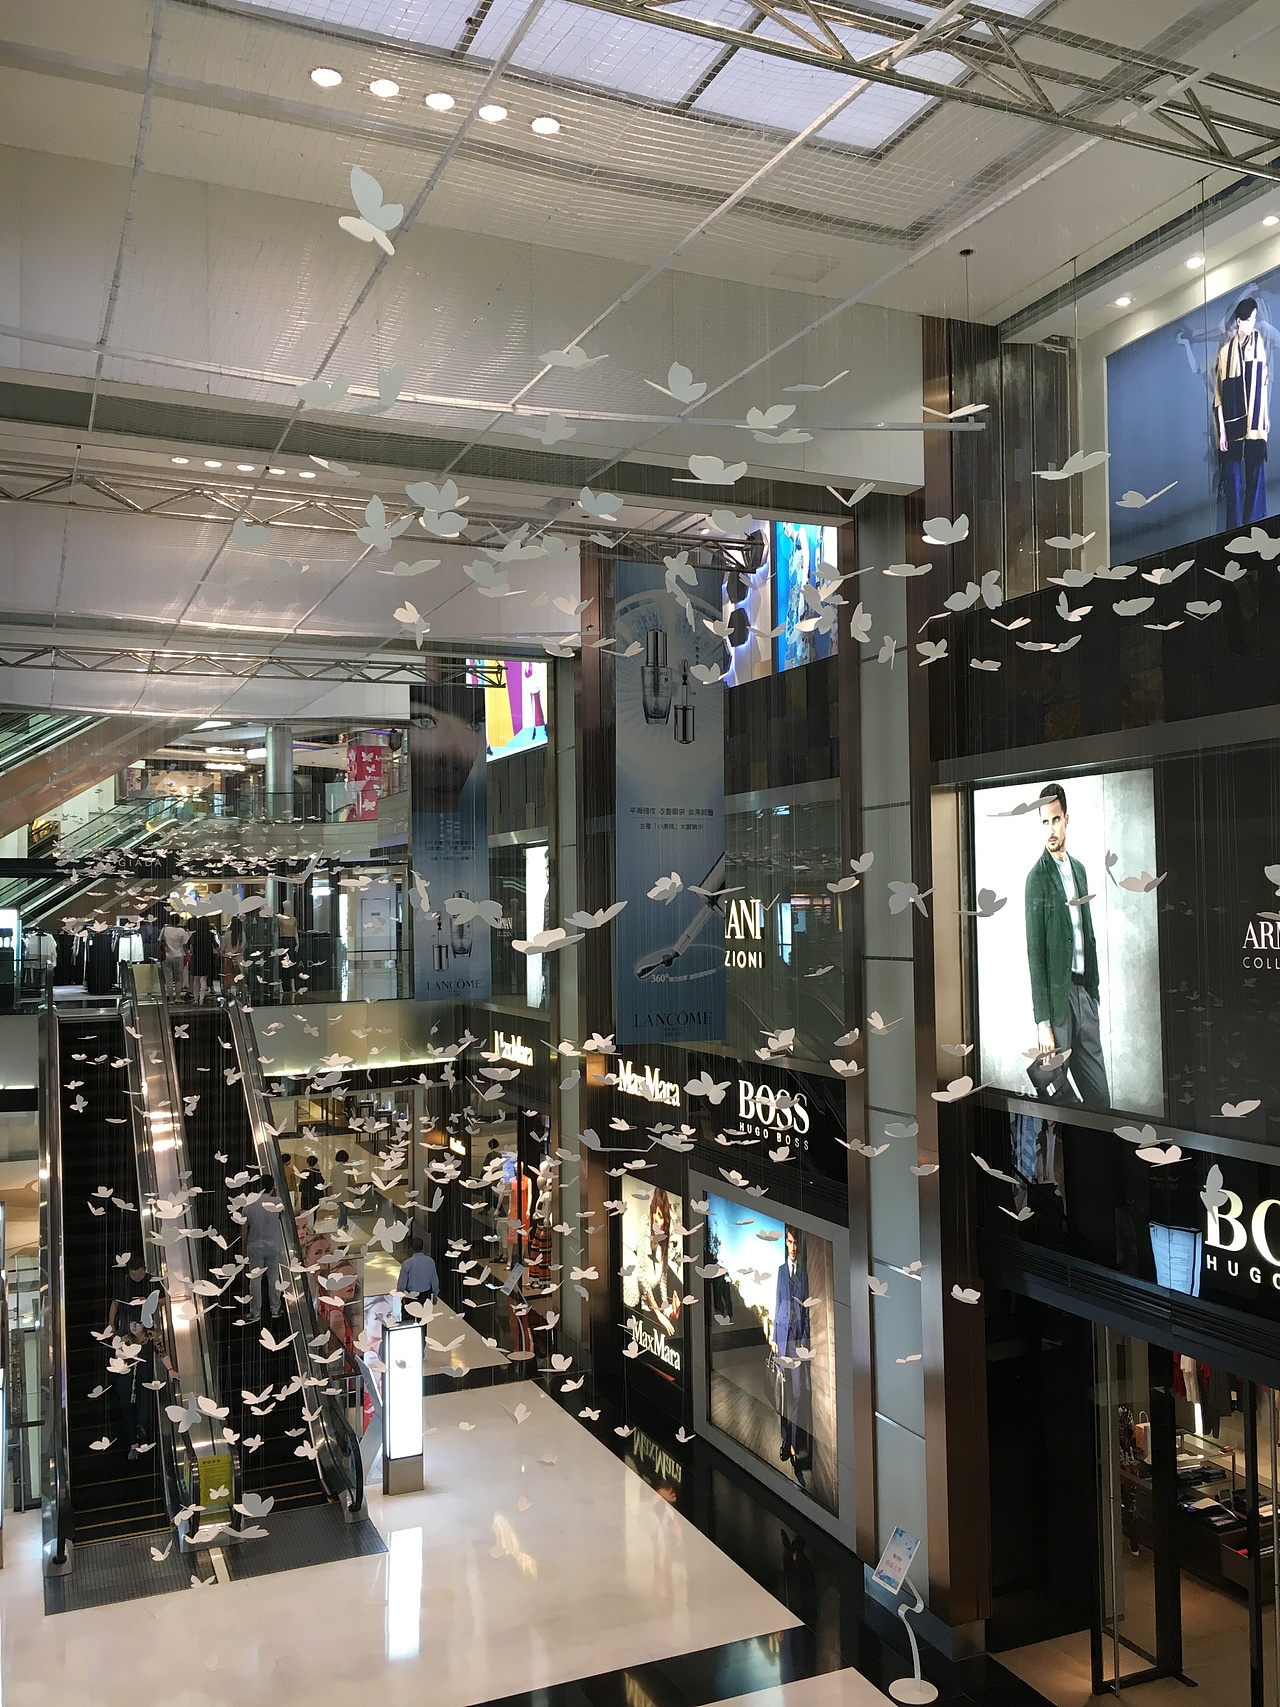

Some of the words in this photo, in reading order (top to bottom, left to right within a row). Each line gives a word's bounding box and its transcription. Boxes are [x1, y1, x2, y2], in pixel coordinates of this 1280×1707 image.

[725, 899, 761, 939] ANI
[1242, 921, 1280, 949] AR
[635, 1010, 712, 1027] LANCÔME
[739, 1080, 809, 1134] BOSS
[740, 1122, 769, 1139] HUGO
[777, 1133, 809, 1151] BOSS
